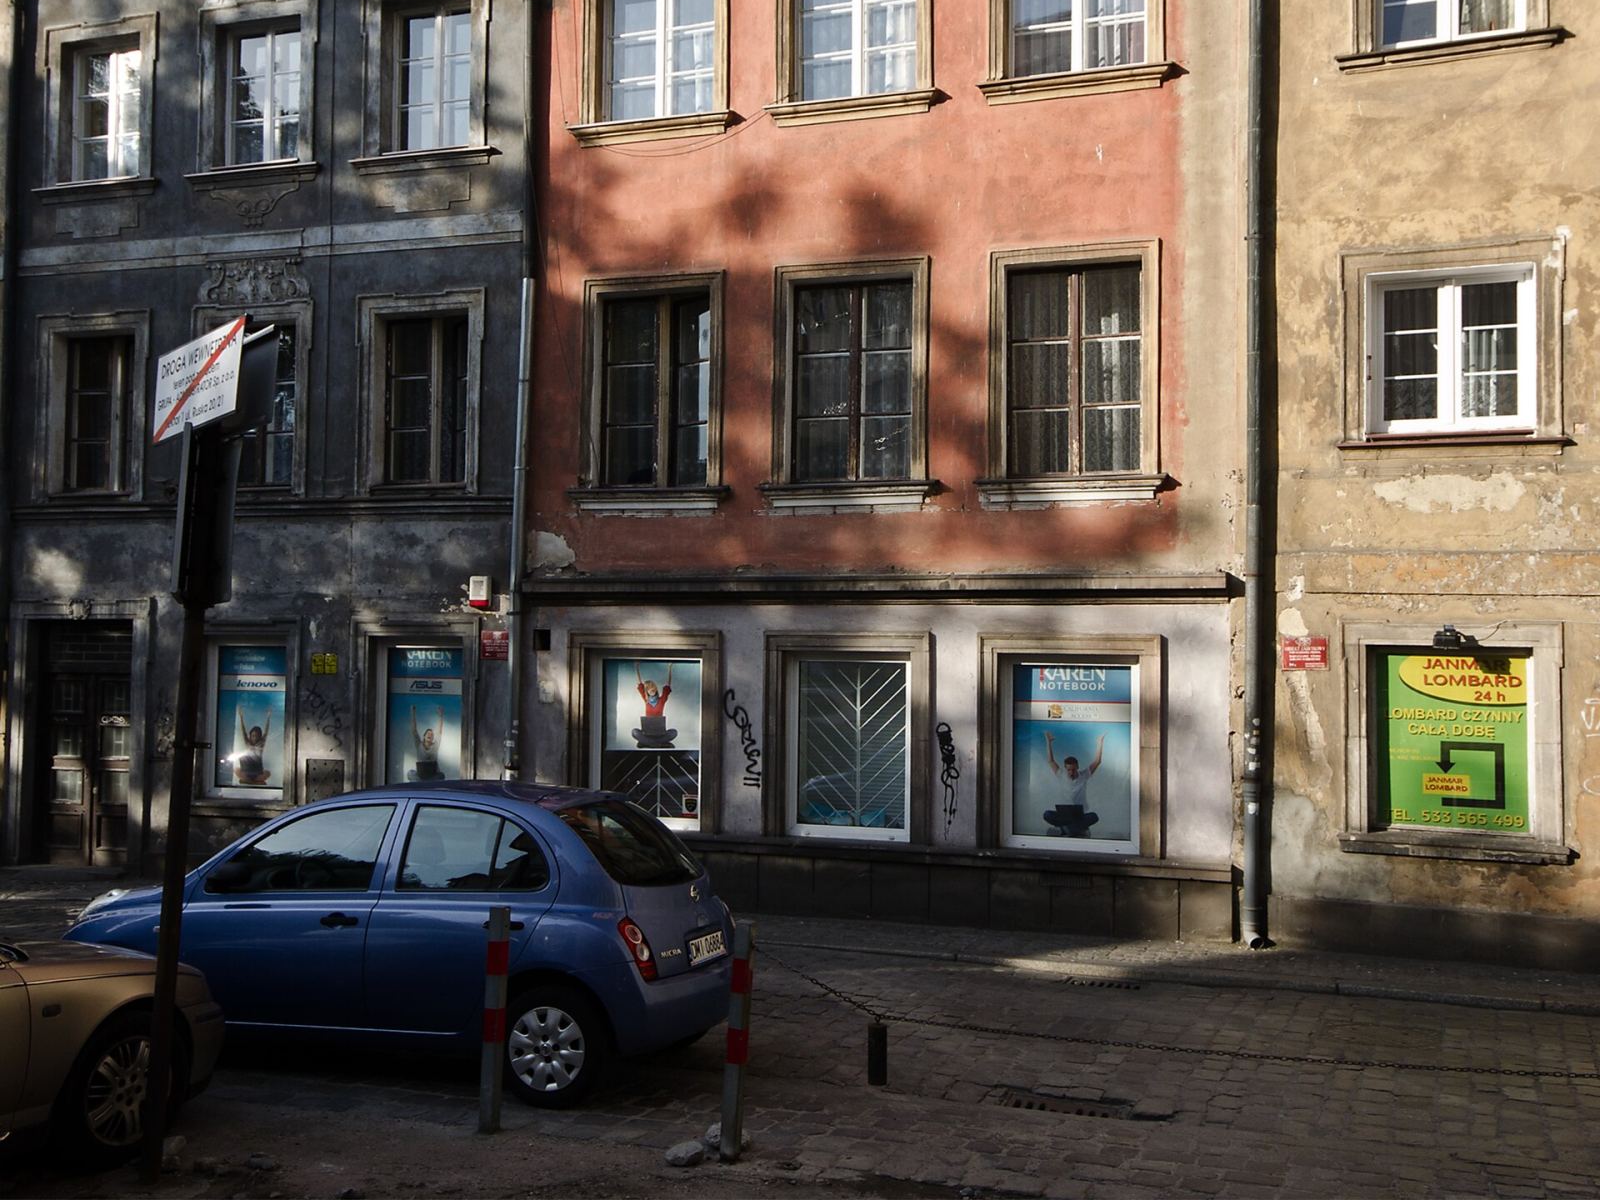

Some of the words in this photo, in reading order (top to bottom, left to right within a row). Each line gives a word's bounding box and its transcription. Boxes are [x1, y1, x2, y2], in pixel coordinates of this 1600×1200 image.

[161, 354, 186, 379] DROGA
[402, 660, 452, 668] NOTEBOOK
[1422, 658, 1507, 672] JANMAR
[236, 680, 277, 688] lenovo
[409, 681, 443, 689] ASUS
[1039, 681, 1105, 691] NOTEBOOK
[1424, 674, 1522, 688] LOMBARD
[1474, 691, 1492, 702] 24
[1497, 691, 1506, 702] h
[1385, 707, 1457, 721] LOMBARD
[1461, 709, 1523, 724] CZYNNY
[1407, 723, 1449, 739] CAŁĄ
[1452, 725, 1496, 740] DOBĘ
[1425, 784, 1469, 792] LOMBARD
[1385, 808, 1416, 822] TEL.
[1422, 810, 1451, 823] 533
[1457, 812, 1488, 826] 565
[1493, 814, 1525, 828] 499
[661, 948, 682, 958] MICRA
